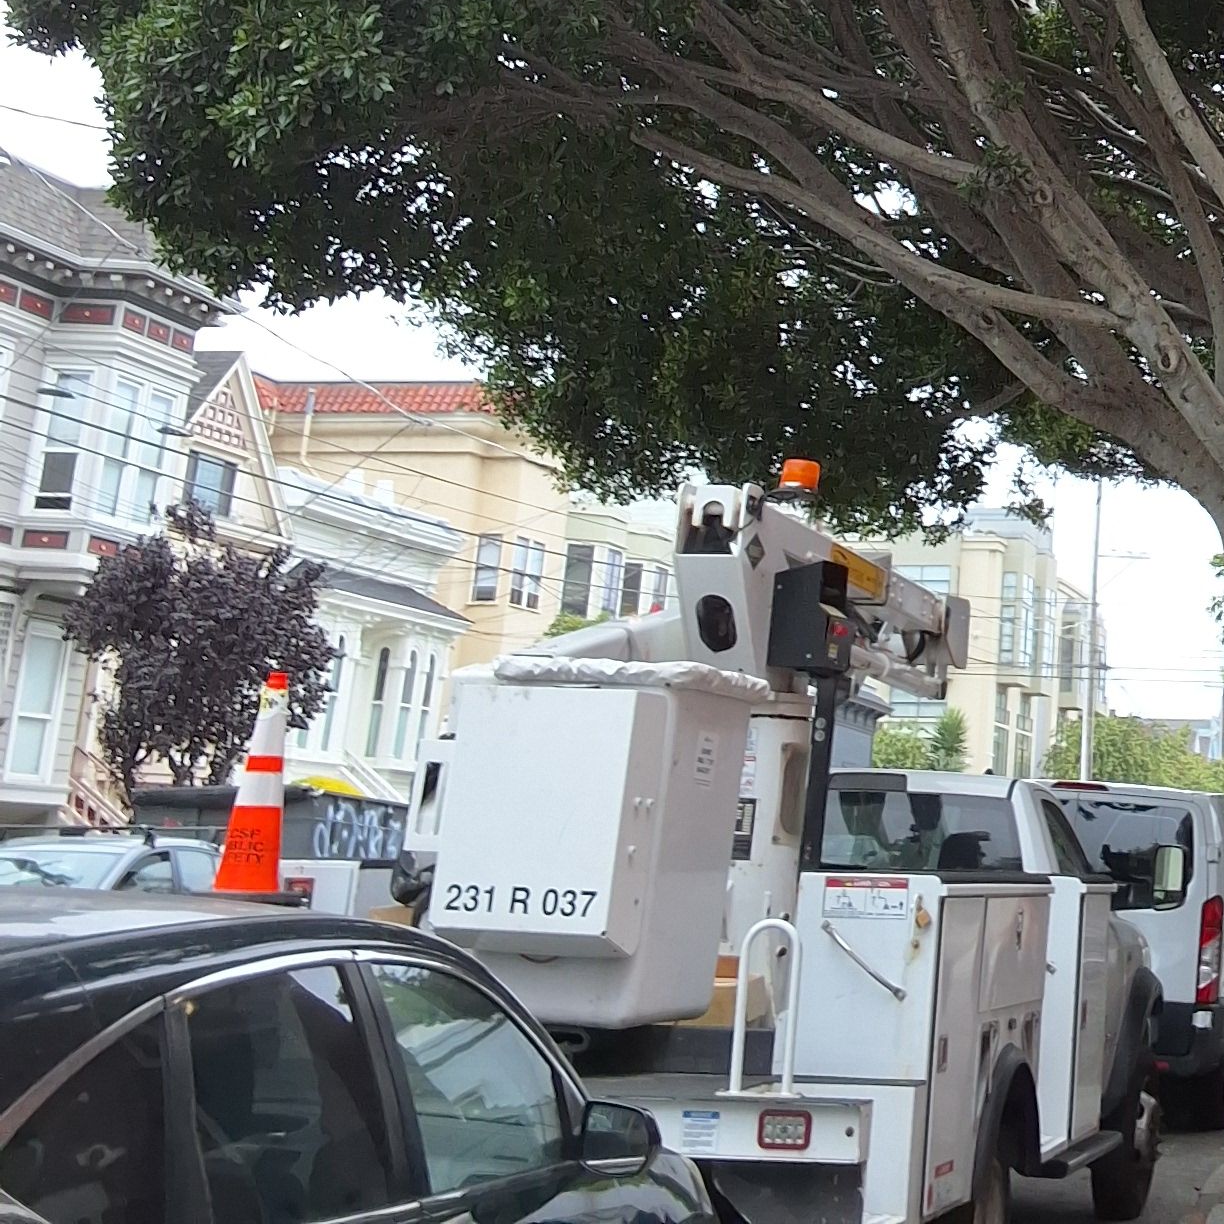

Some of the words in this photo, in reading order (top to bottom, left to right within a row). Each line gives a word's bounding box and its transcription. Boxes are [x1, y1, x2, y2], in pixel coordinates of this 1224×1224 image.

[444, 884, 495, 912] 231
[509, 886, 531, 915] R
[542, 888, 598, 917] 037
